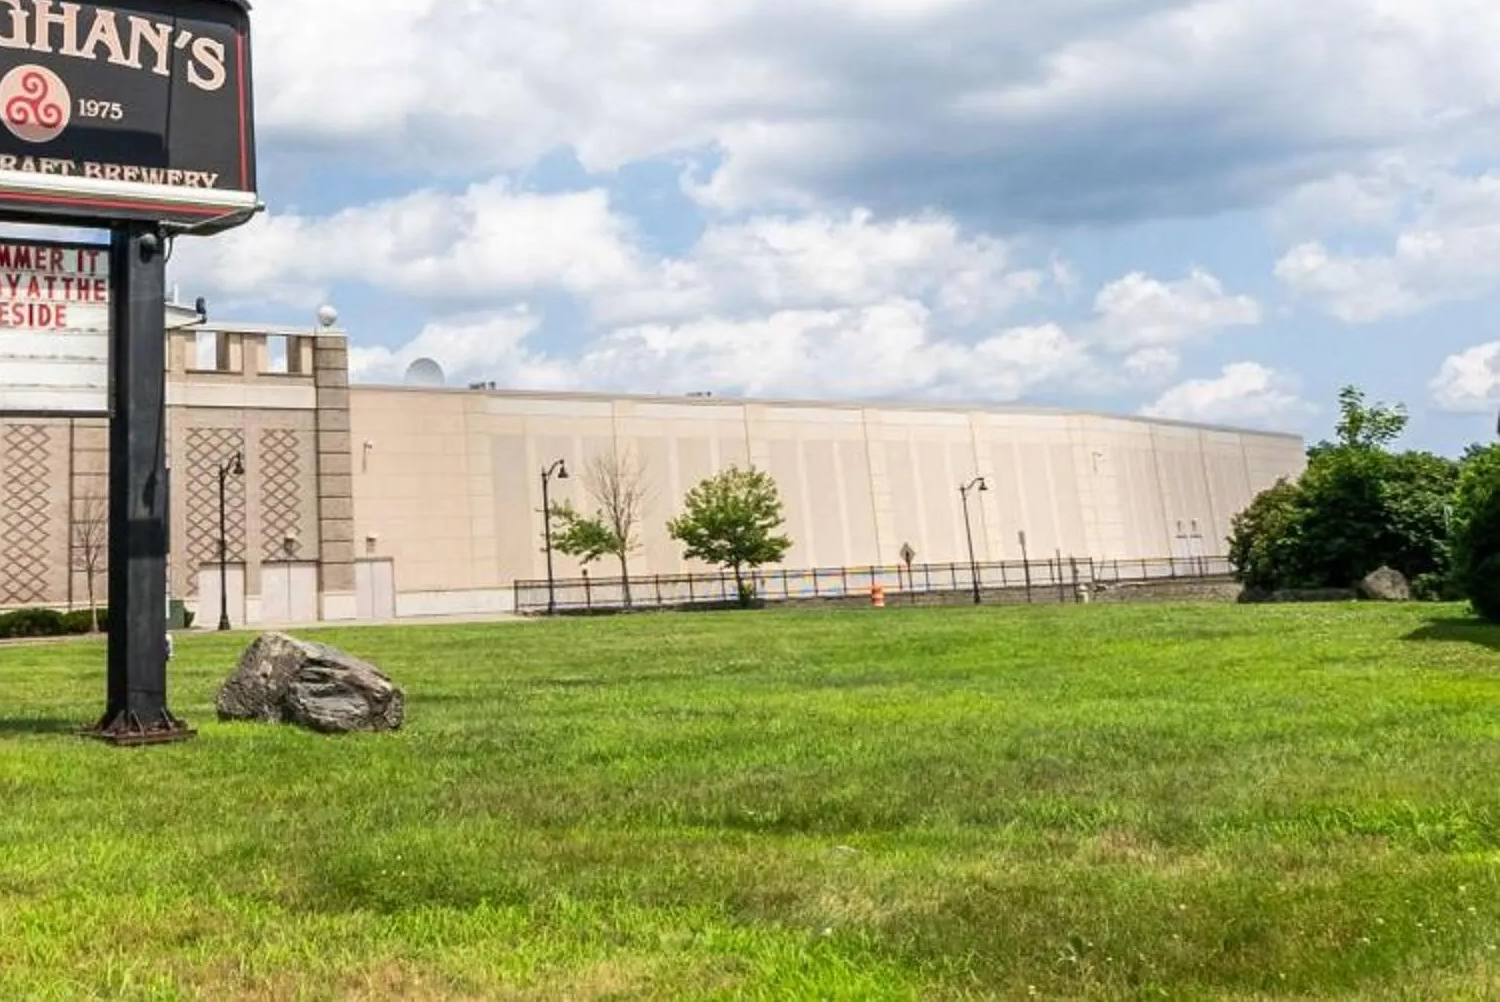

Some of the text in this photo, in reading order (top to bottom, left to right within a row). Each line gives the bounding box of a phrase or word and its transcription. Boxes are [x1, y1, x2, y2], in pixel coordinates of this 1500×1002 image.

[78, 98, 124, 120] 1975
[76, 248, 101, 276] IT
[27, 274, 58, 299] AT
[60, 276, 107, 303] THE
